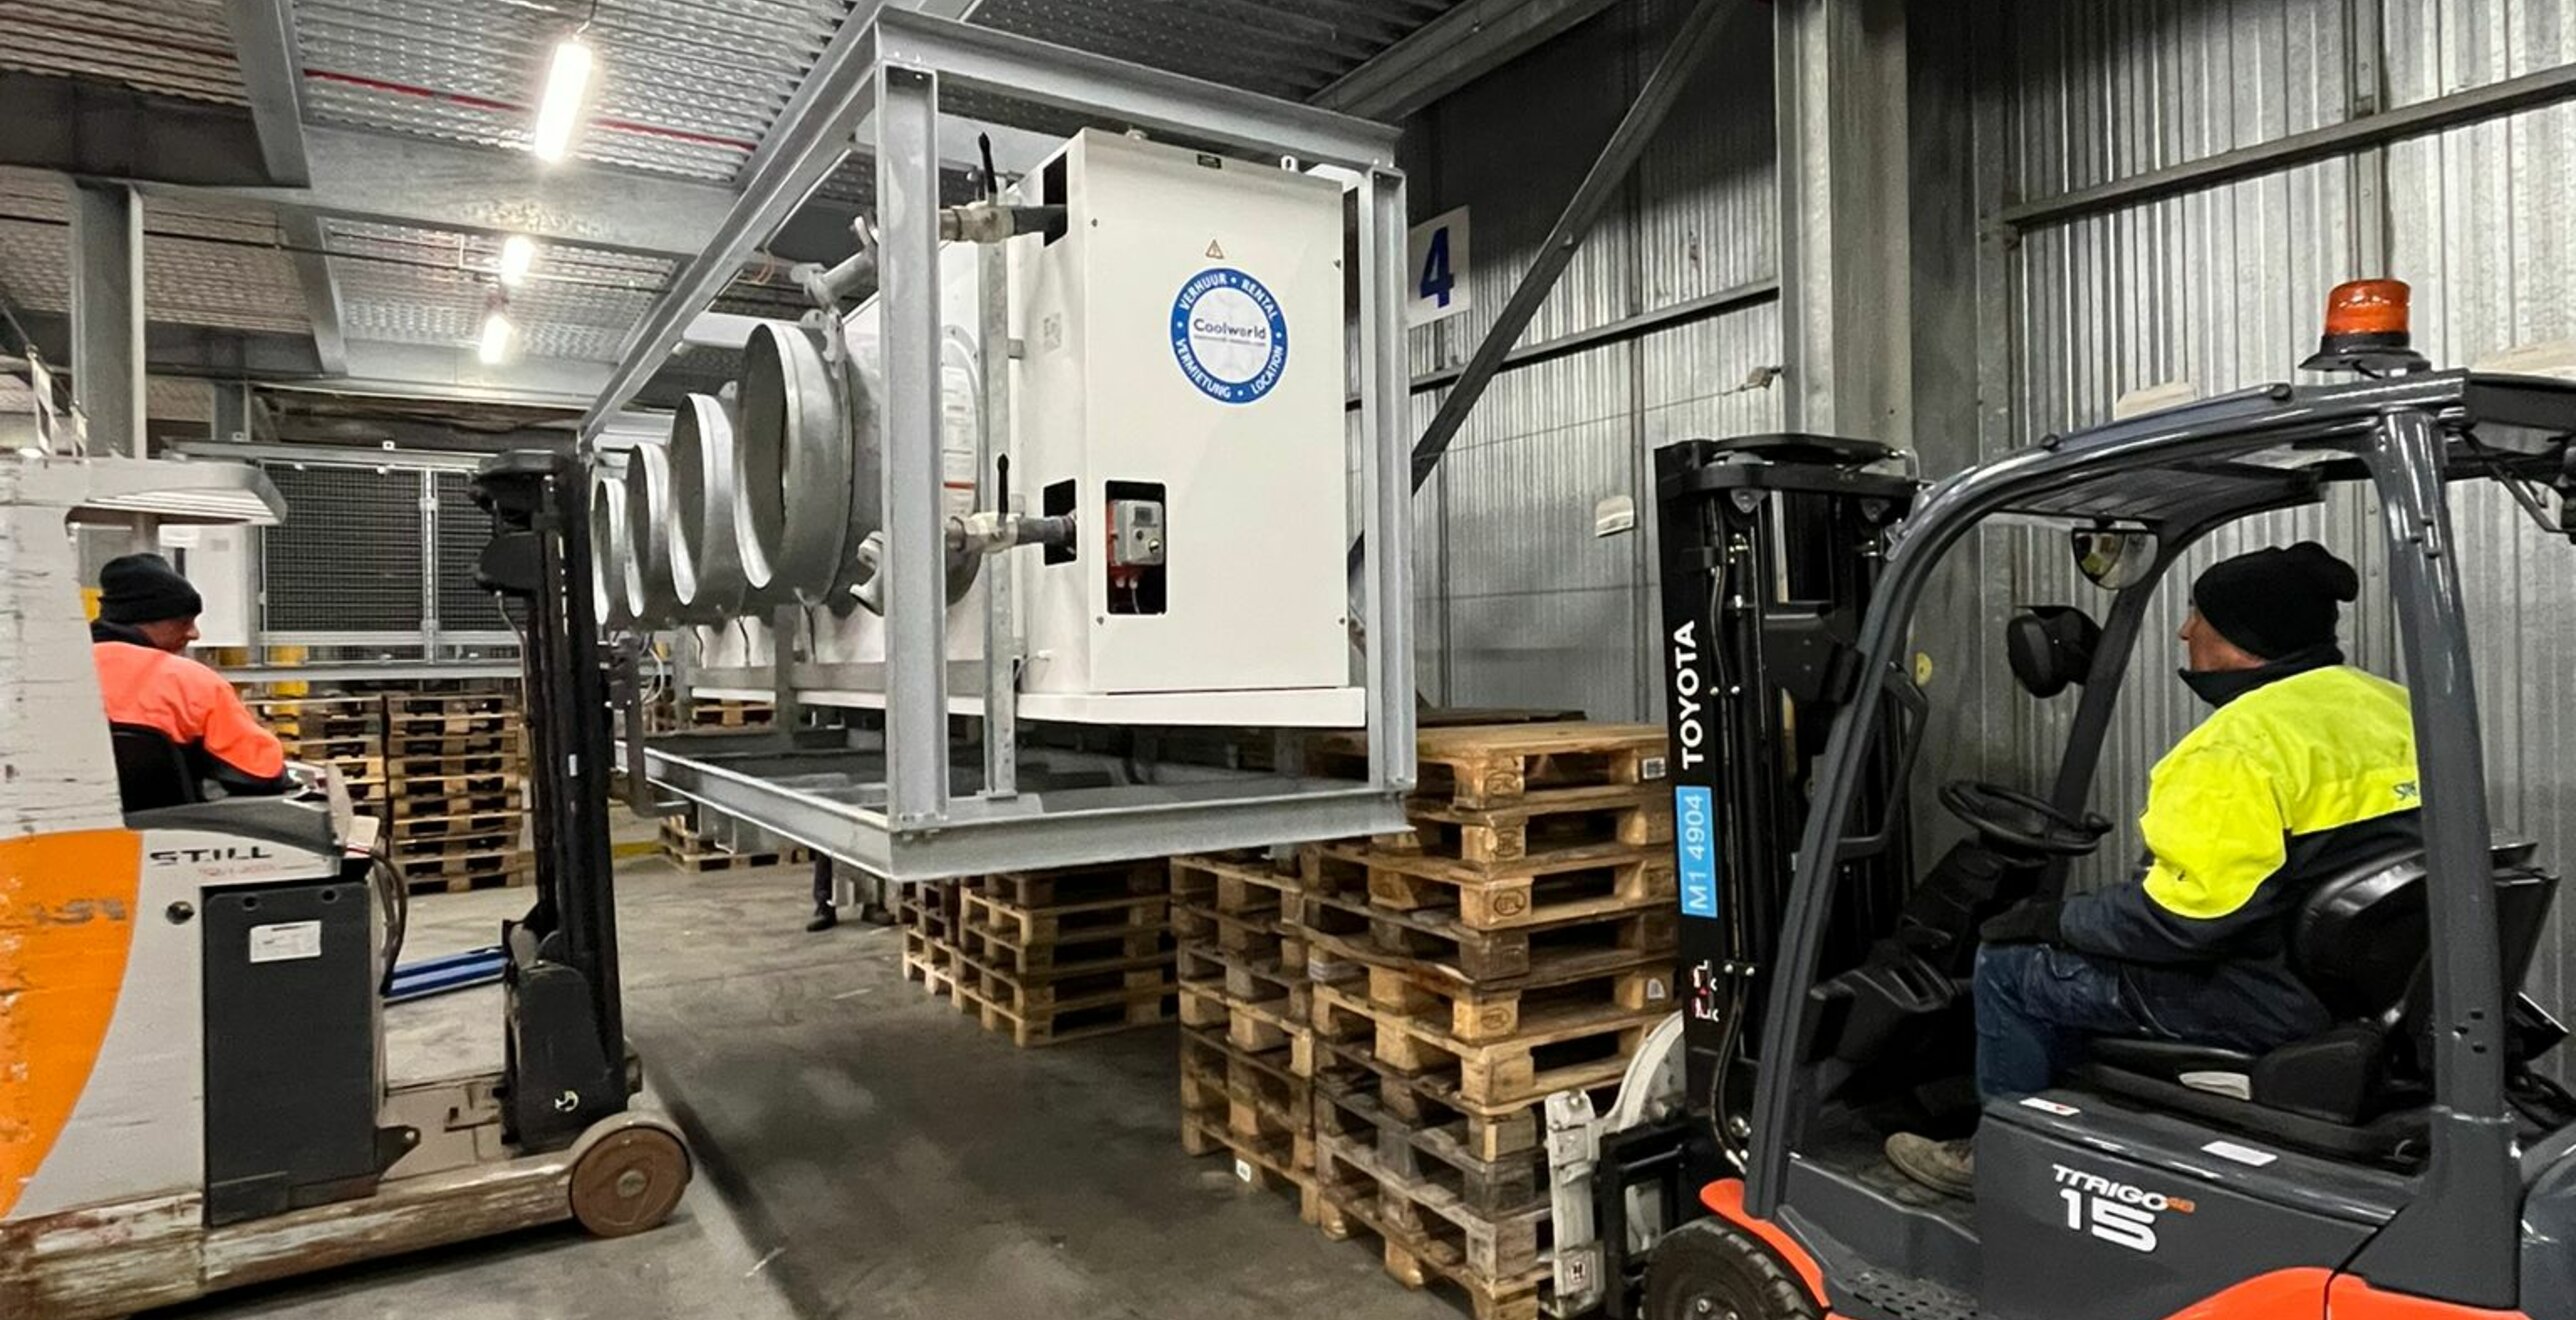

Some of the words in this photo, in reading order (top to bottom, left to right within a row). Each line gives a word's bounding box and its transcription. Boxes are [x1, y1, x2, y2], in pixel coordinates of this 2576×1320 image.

[1178, 272, 1227, 311] VERHUUR
[1420, 225, 1454, 309] 4
[1240, 278, 1279, 321] RENTAL
[1193, 317, 1267, 340] Coolworld
[1175, 337, 1232, 399] VERMIETUNG
[1250, 345, 1284, 395] LOCATION
[1673, 619, 1705, 770] TOYOTA
[1683, 794, 1706, 860] 4904
[1688, 871, 1709, 910] M1
[2059, 1187, 2158, 1253] 15
